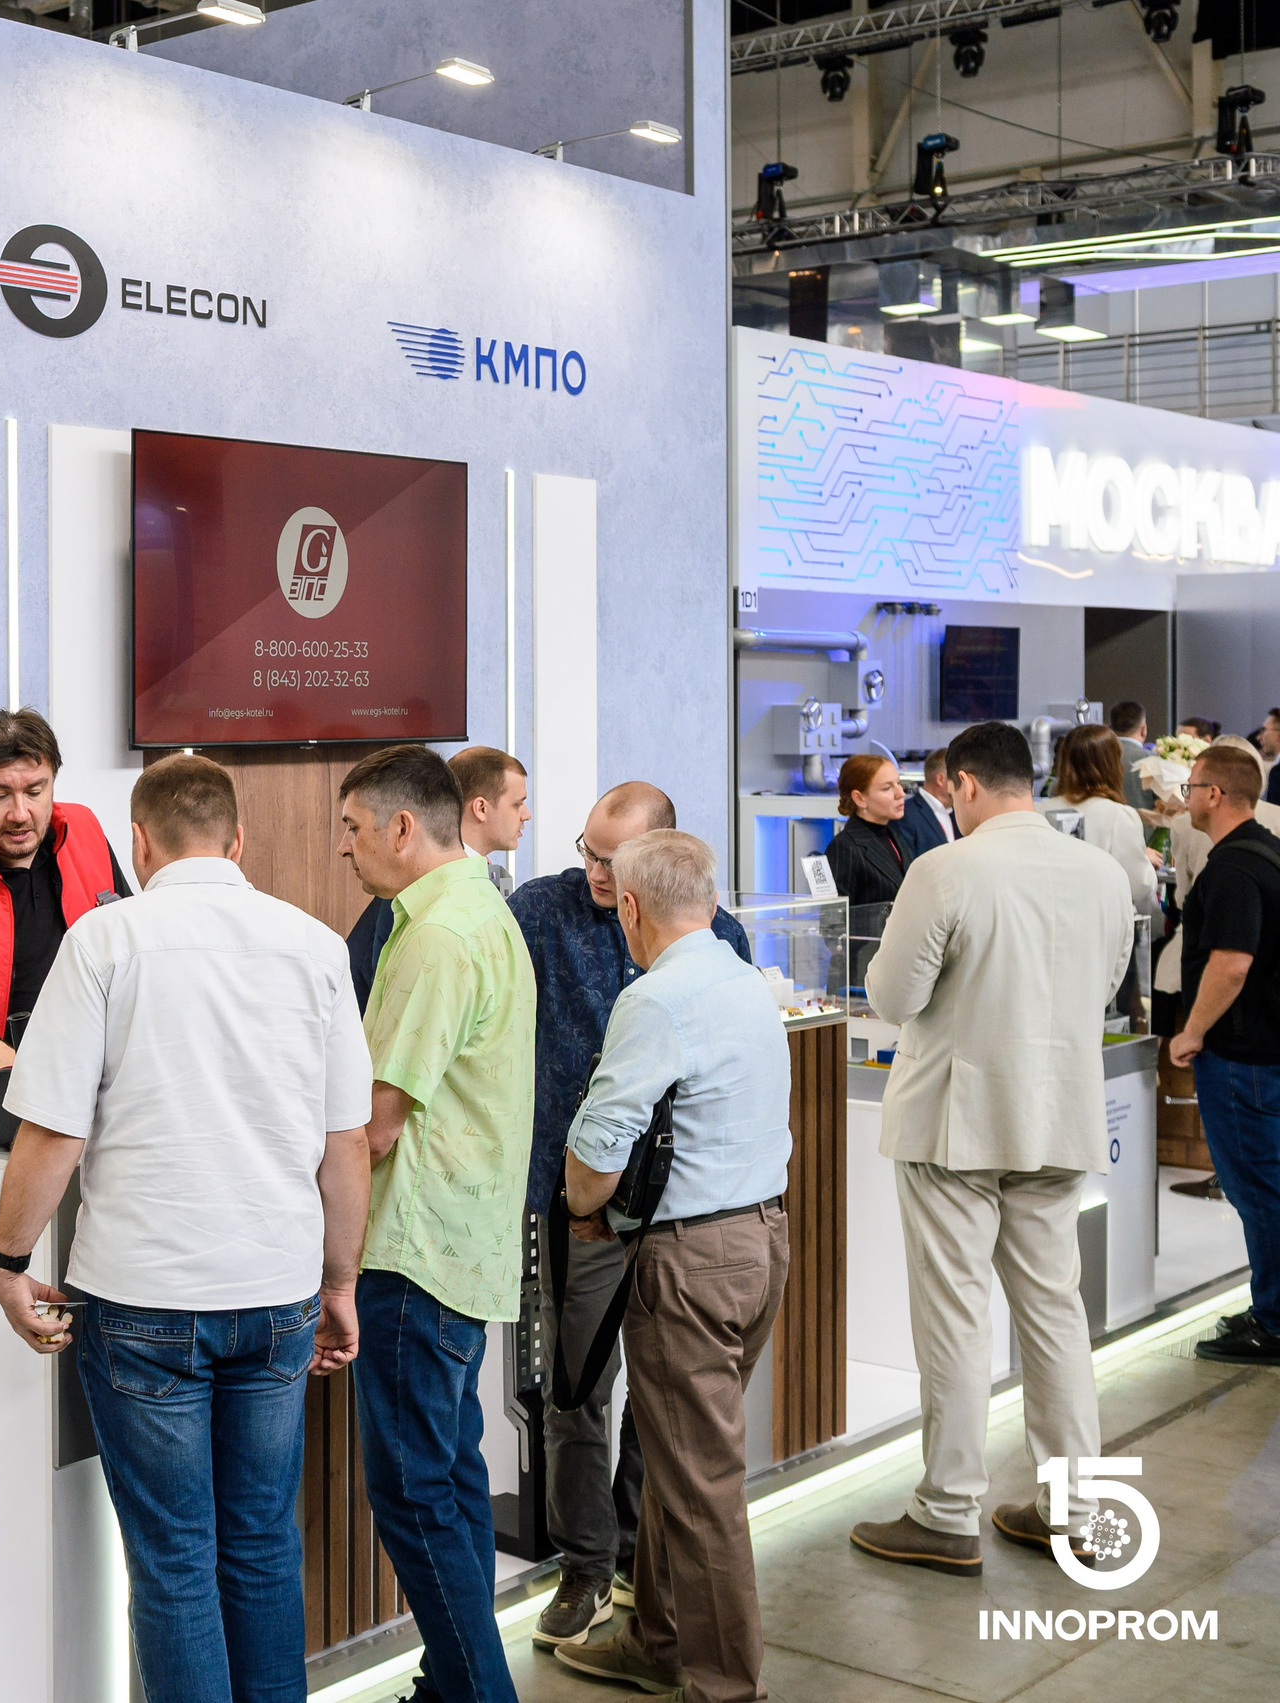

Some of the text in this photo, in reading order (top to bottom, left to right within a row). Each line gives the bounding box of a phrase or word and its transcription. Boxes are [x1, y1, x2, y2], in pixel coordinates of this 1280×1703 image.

[121, 277, 267, 328] ELECON
[475, 337, 586, 396] КМПО
[254, 640, 369, 658] 8-800-600-25-33
[253, 669, 370, 691] 8 (843) 202-32-63
[208, 707, 274, 719] info@egs-kotel.ru
[351, 706, 409, 717] www.egs-kotel.ru
